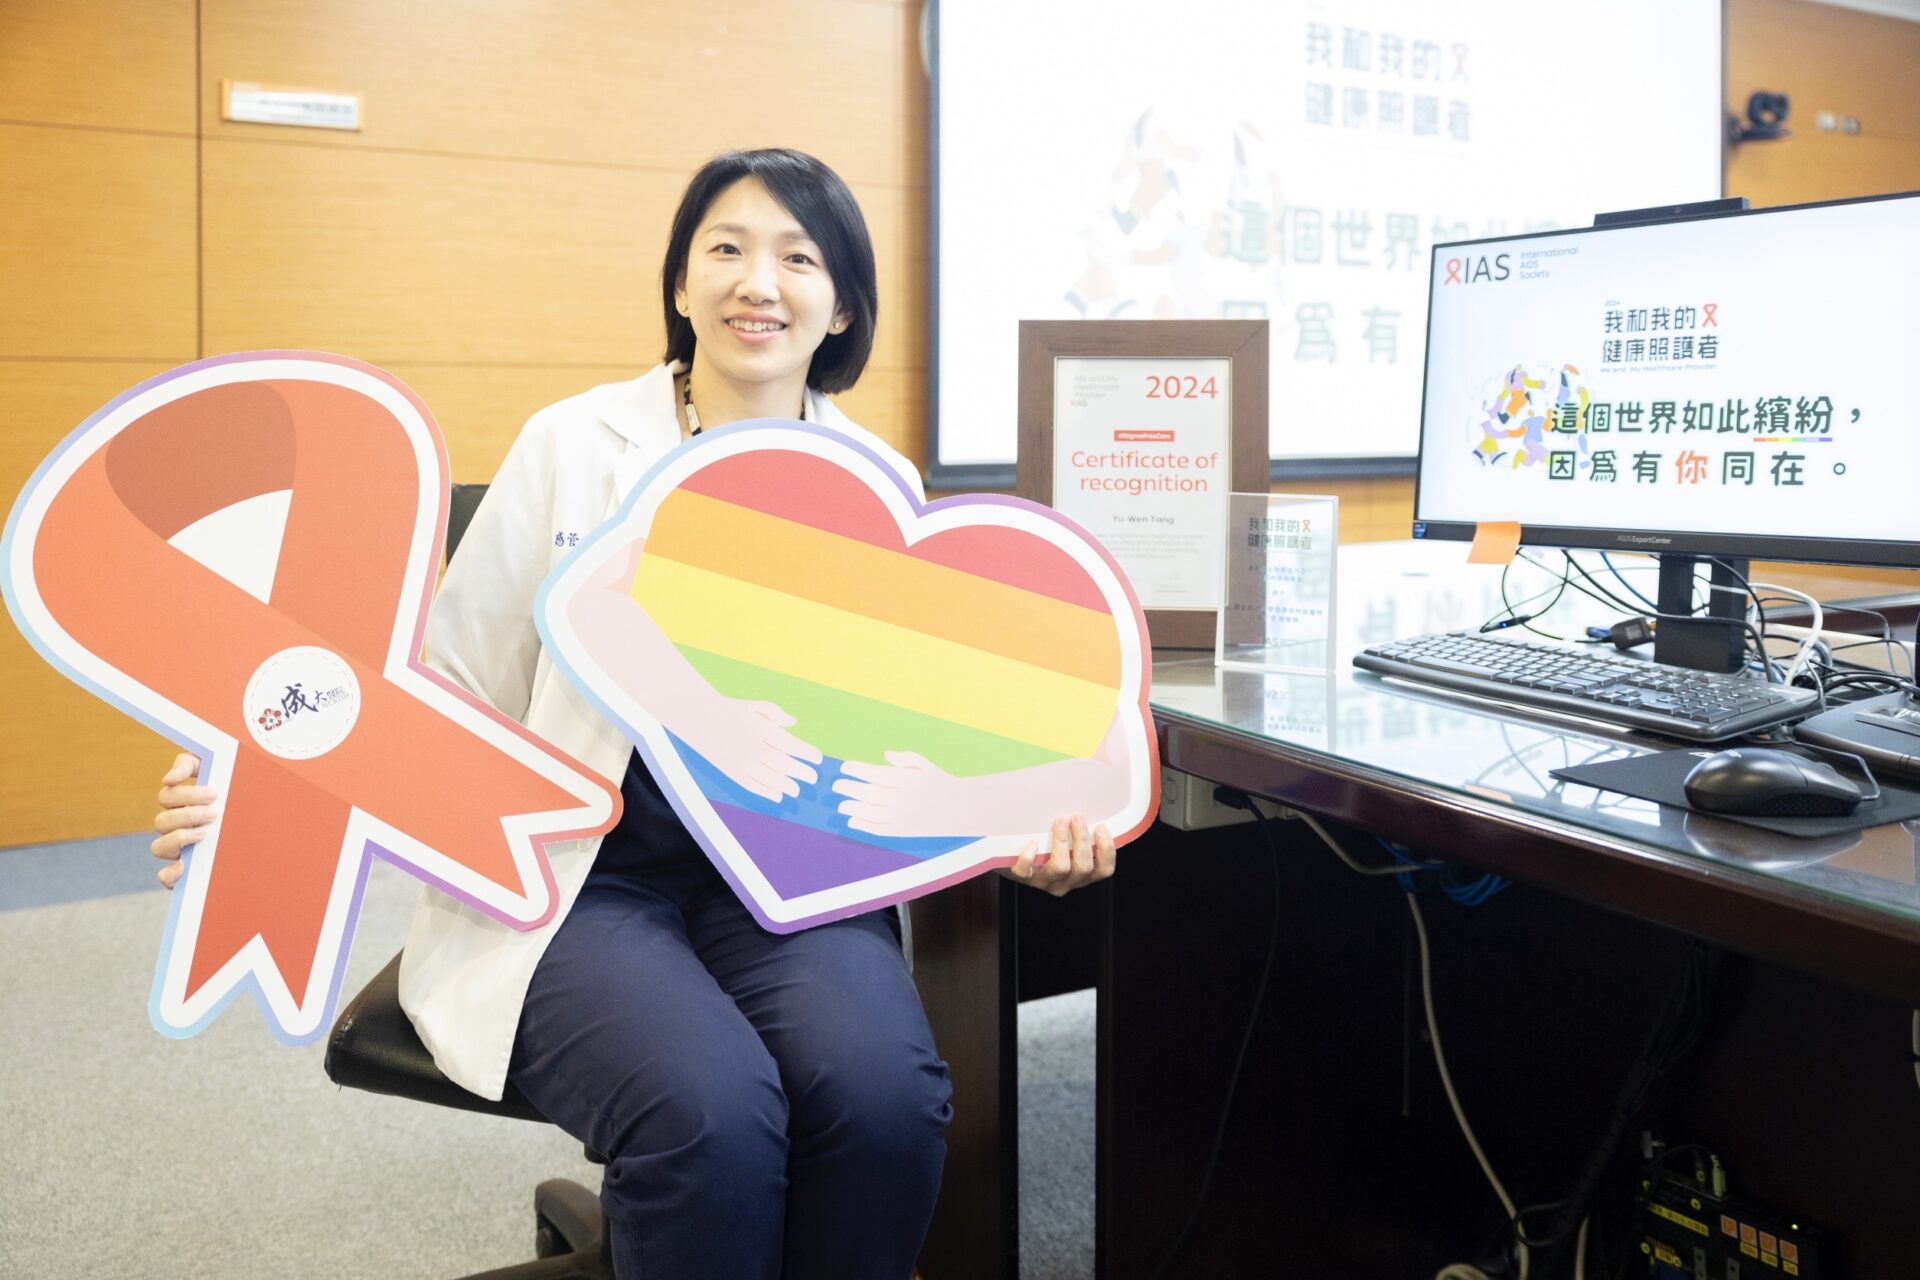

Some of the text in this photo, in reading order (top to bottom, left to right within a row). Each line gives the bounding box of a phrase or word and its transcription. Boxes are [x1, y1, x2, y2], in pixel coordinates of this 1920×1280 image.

[1306, 21, 1441, 82] 我和我的
[1520, 246, 1579, 260] International
[1465, 253, 1510, 284] IAS
[1519, 270, 1551, 280] Society
[1520, 260, 1539, 270] AIDS
[1604, 306, 1697, 333] 我和我的
[1602, 334, 1720, 363] 健康照護者
[1145, 375, 1219, 399] 2024
[1071, 450, 1218, 470] Certificate of
[1080, 474, 1208, 496] recognition
[1248, 517, 1300, 532] 我和我的
